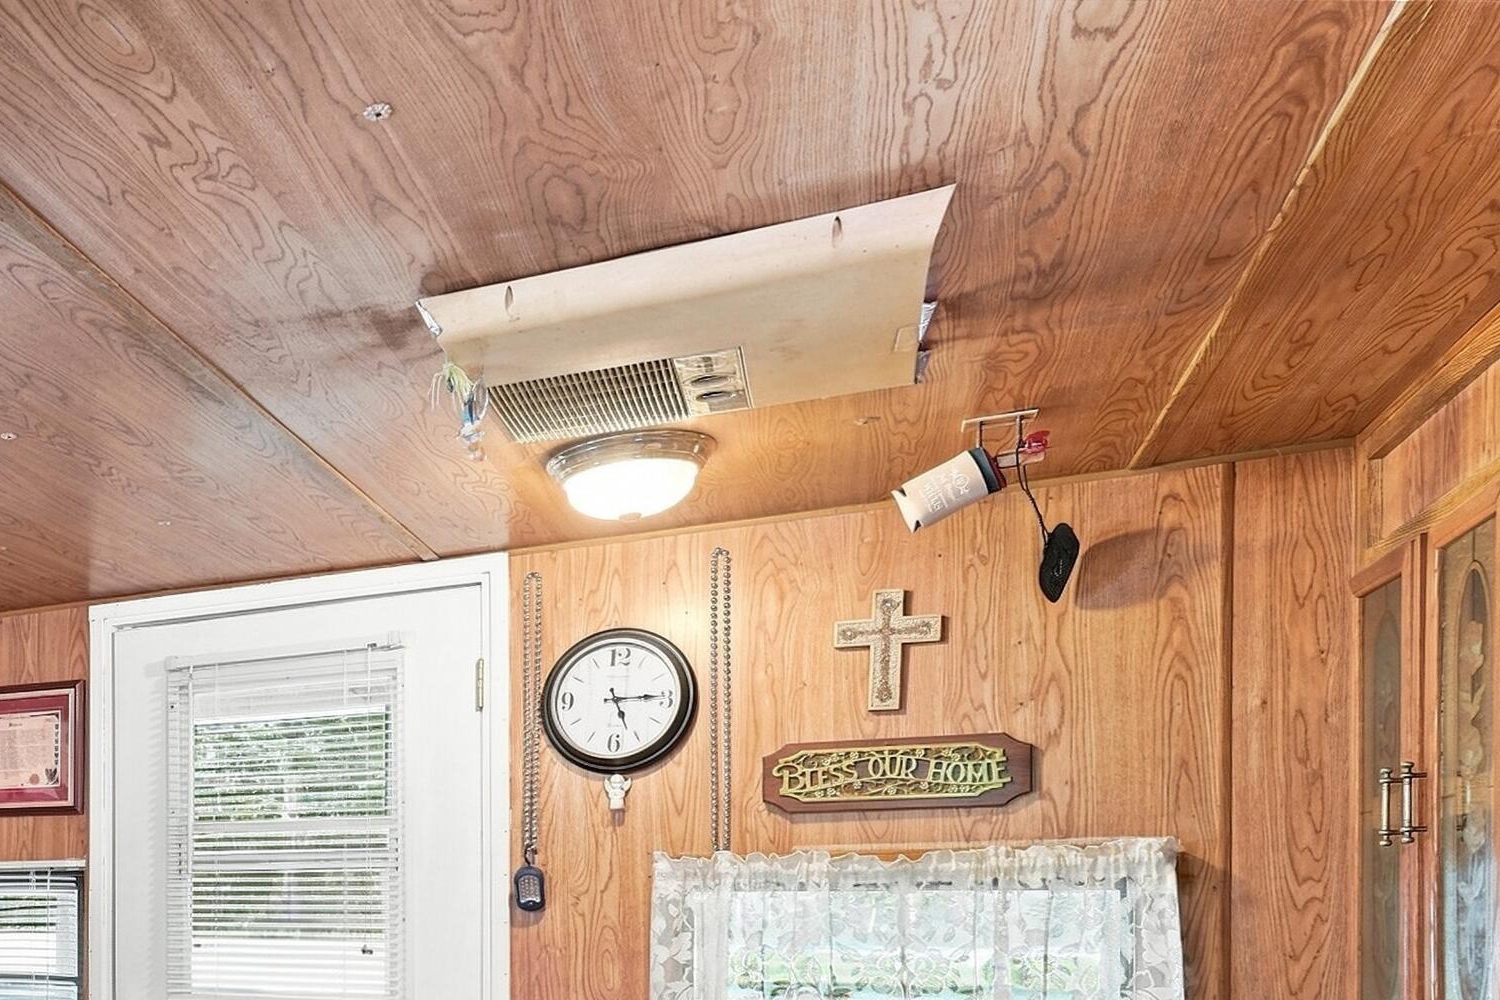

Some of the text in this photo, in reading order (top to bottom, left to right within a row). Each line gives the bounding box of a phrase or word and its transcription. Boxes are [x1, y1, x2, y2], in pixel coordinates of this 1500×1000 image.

[610, 648, 631, 667] 12
[561, 692, 574, 711] 9
[660, 690, 673, 708] 3
[607, 733, 621, 752] 6
[772, 755, 1012, 793] BLESS OUR HOME
